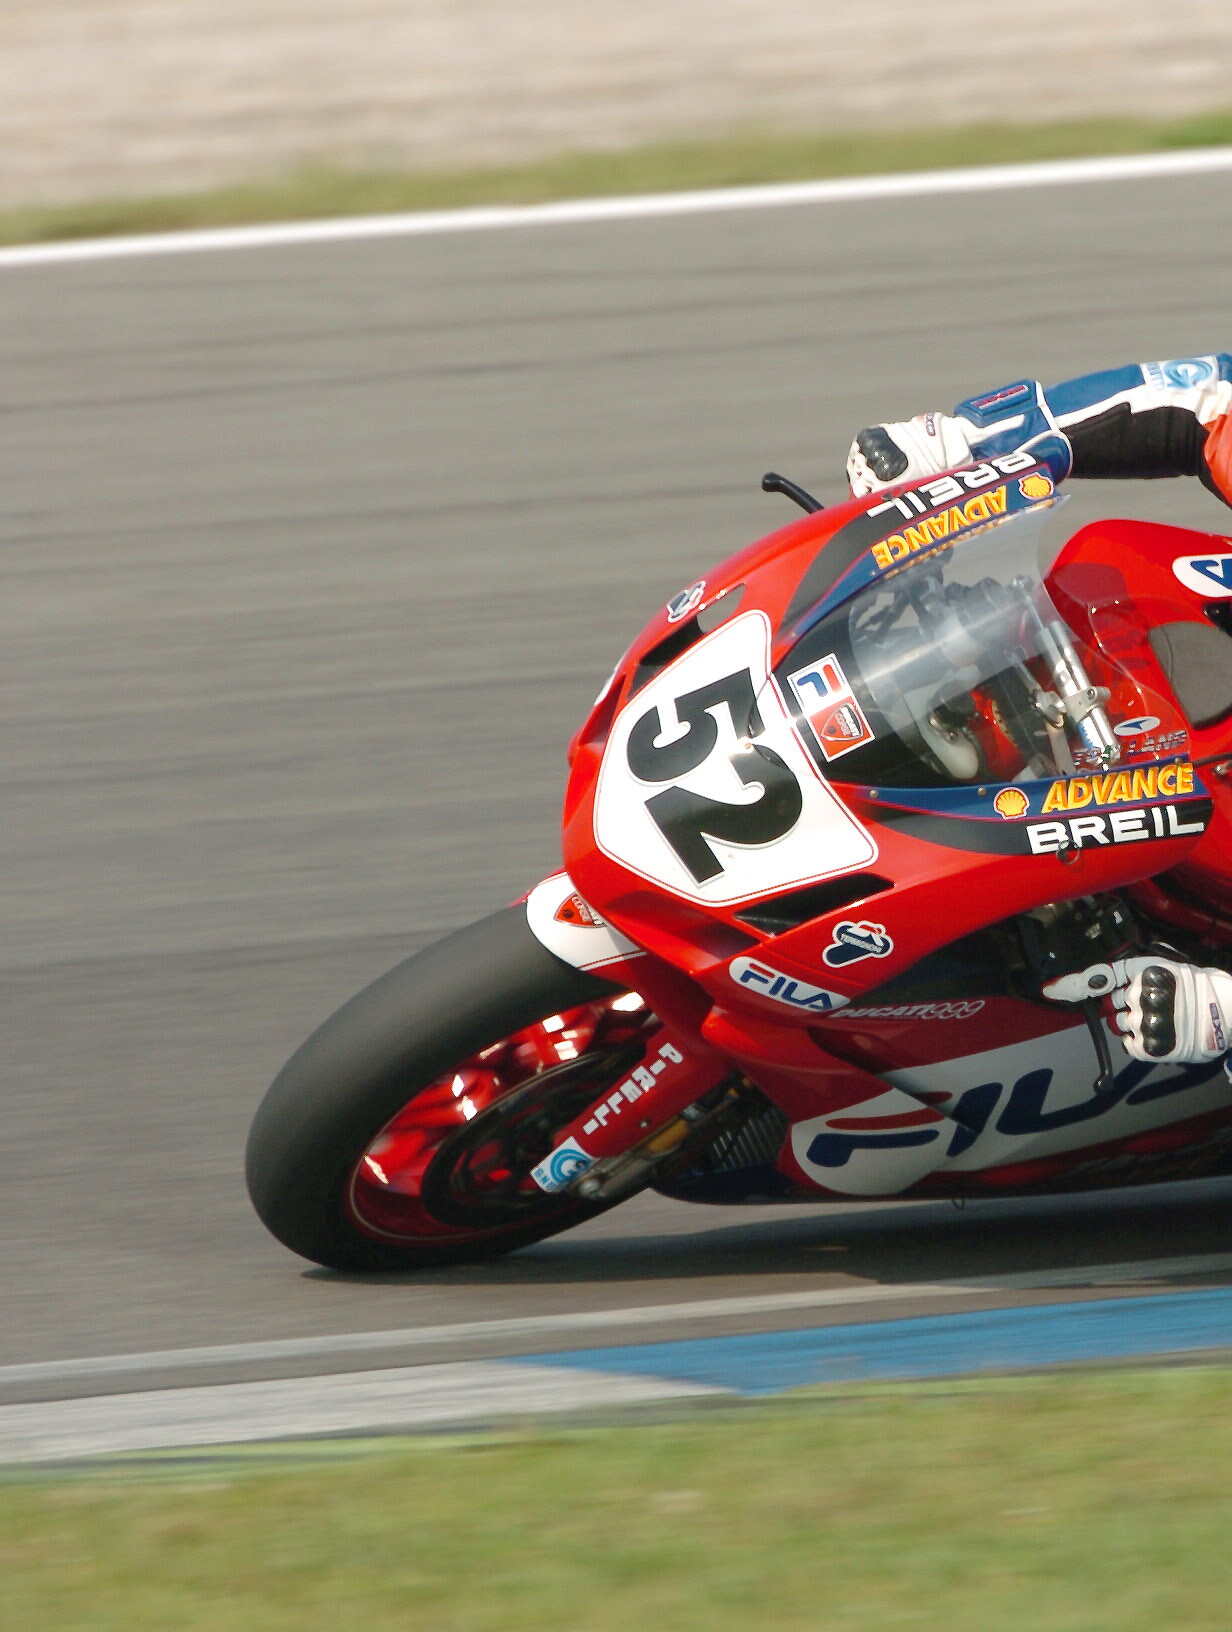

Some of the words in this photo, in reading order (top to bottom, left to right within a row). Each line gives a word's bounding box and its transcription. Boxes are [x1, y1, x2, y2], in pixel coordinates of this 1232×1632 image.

[867, 453, 1036, 520] BREIL
[871, 485, 1008, 569] ADVANCE
[626, 666, 803, 886] 52
[1041, 763, 1194, 814] ADVANCE
[1026, 804, 1205, 855] BREIL
[740, 963, 833, 1011] FILA
[583, 1043, 683, 1136] PIRELLI
